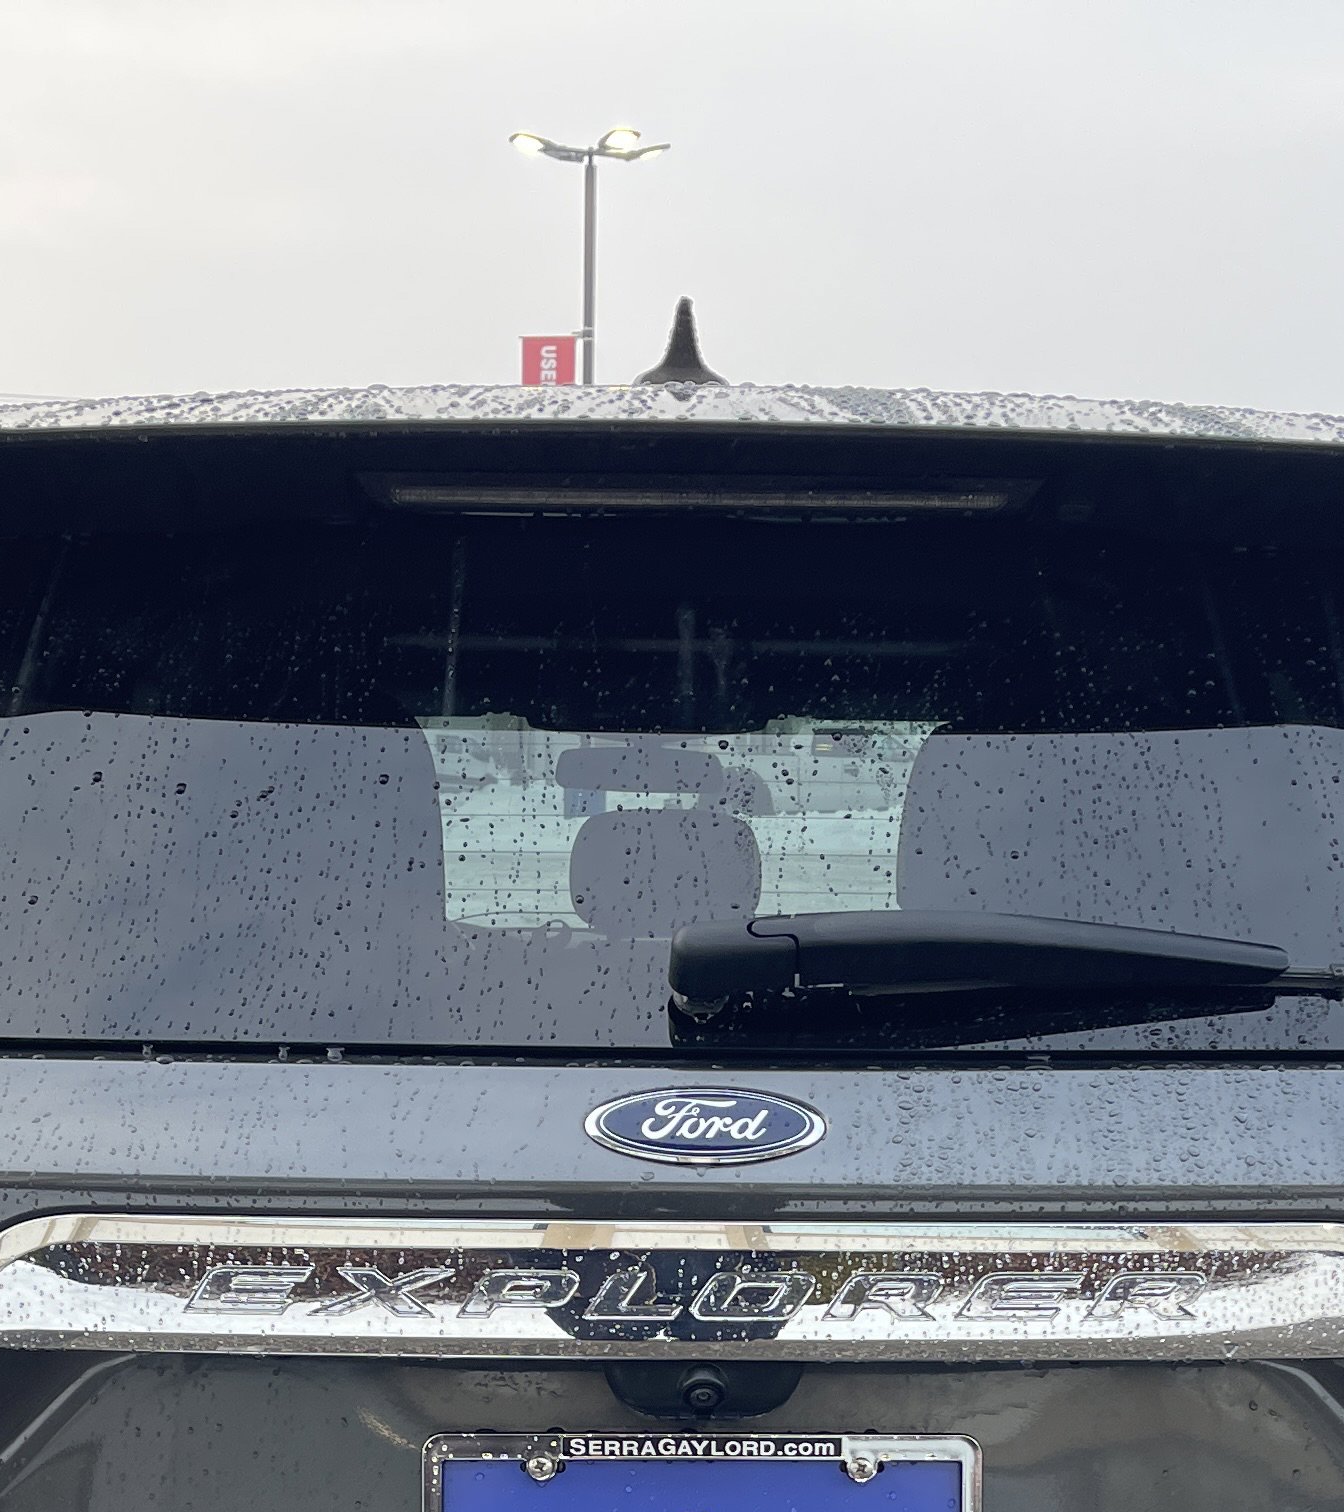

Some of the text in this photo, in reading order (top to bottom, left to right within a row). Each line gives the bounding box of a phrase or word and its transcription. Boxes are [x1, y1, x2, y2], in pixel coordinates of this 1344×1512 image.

[540, 345, 558, 385] USE
[641, 1098, 769, 1140] Ford
[182, 1264, 1208, 1322] EXPLORER
[567, 1437, 836, 1458] SERRAGAYLORD.com
